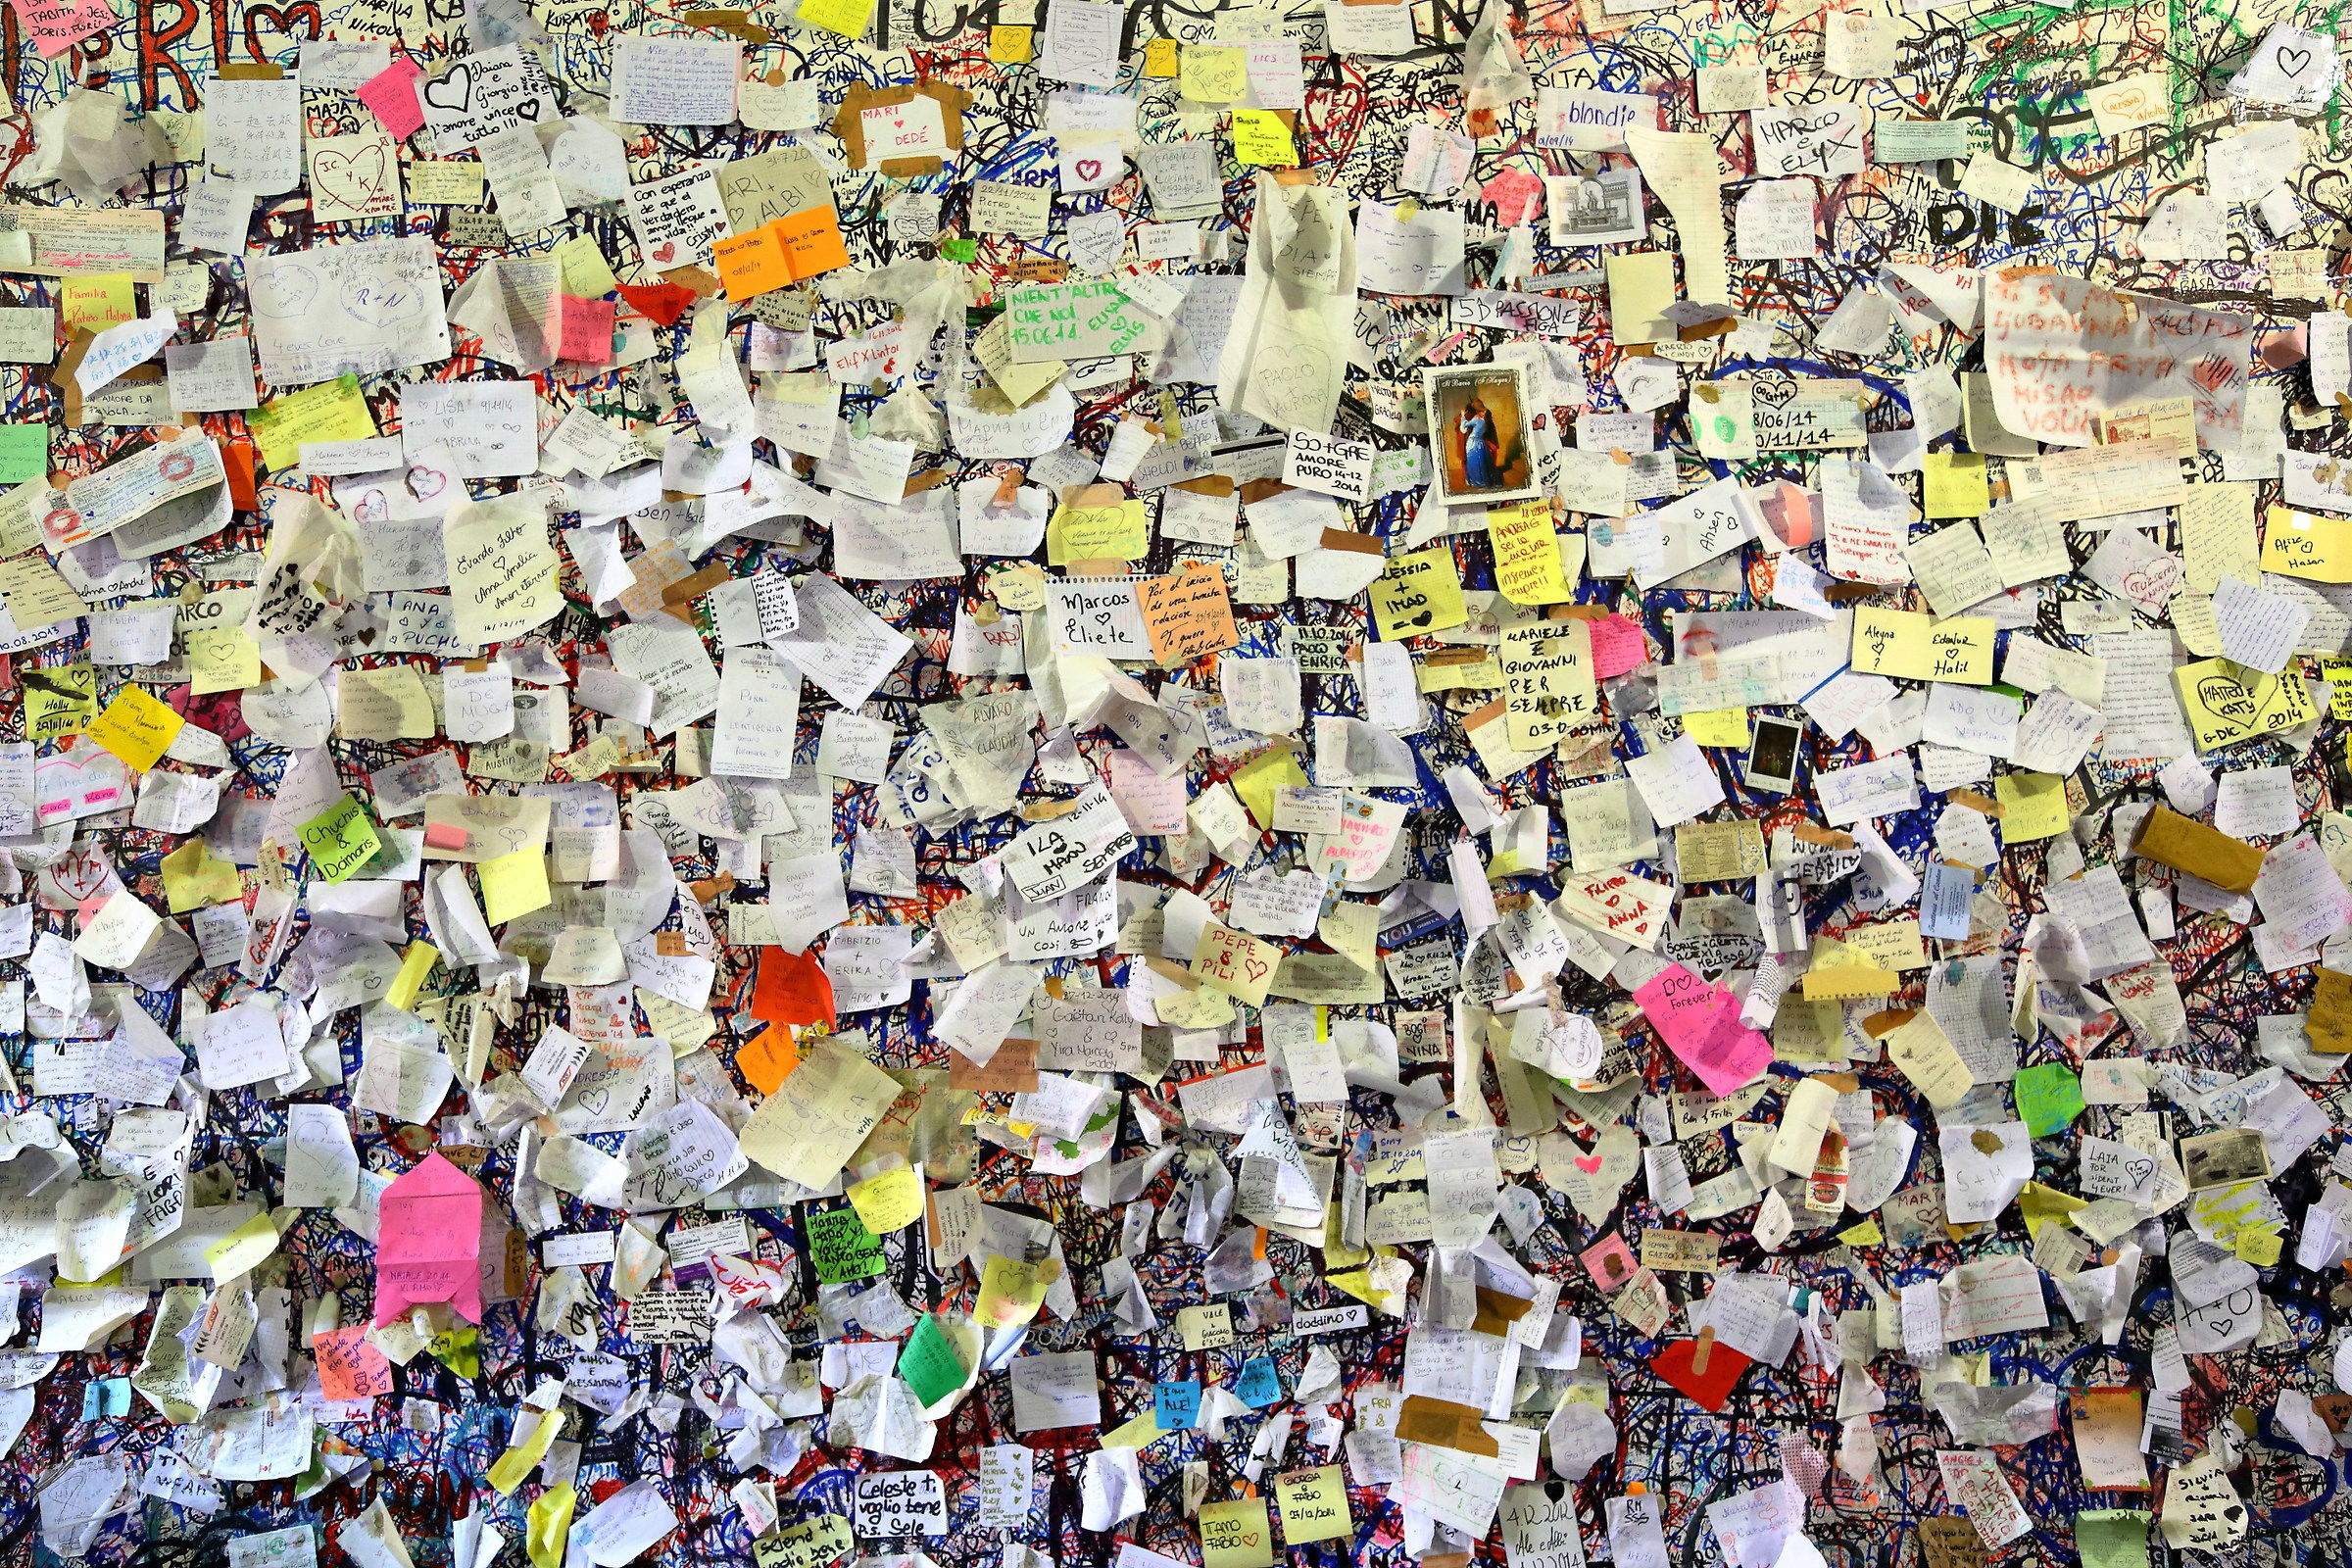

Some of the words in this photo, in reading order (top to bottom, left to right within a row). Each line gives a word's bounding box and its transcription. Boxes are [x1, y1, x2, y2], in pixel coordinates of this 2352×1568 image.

[863, 106, 899, 119] MARI
[1569, 102, 1637, 127] blondie
[403, 602, 440, 613] ANA
[1060, 591, 1130, 610] Marcos
[1933, 661, 1968, 674] Halil
[1210, 930, 1257, 956] PEPE
[858, 1476, 916, 1499] Celeste
